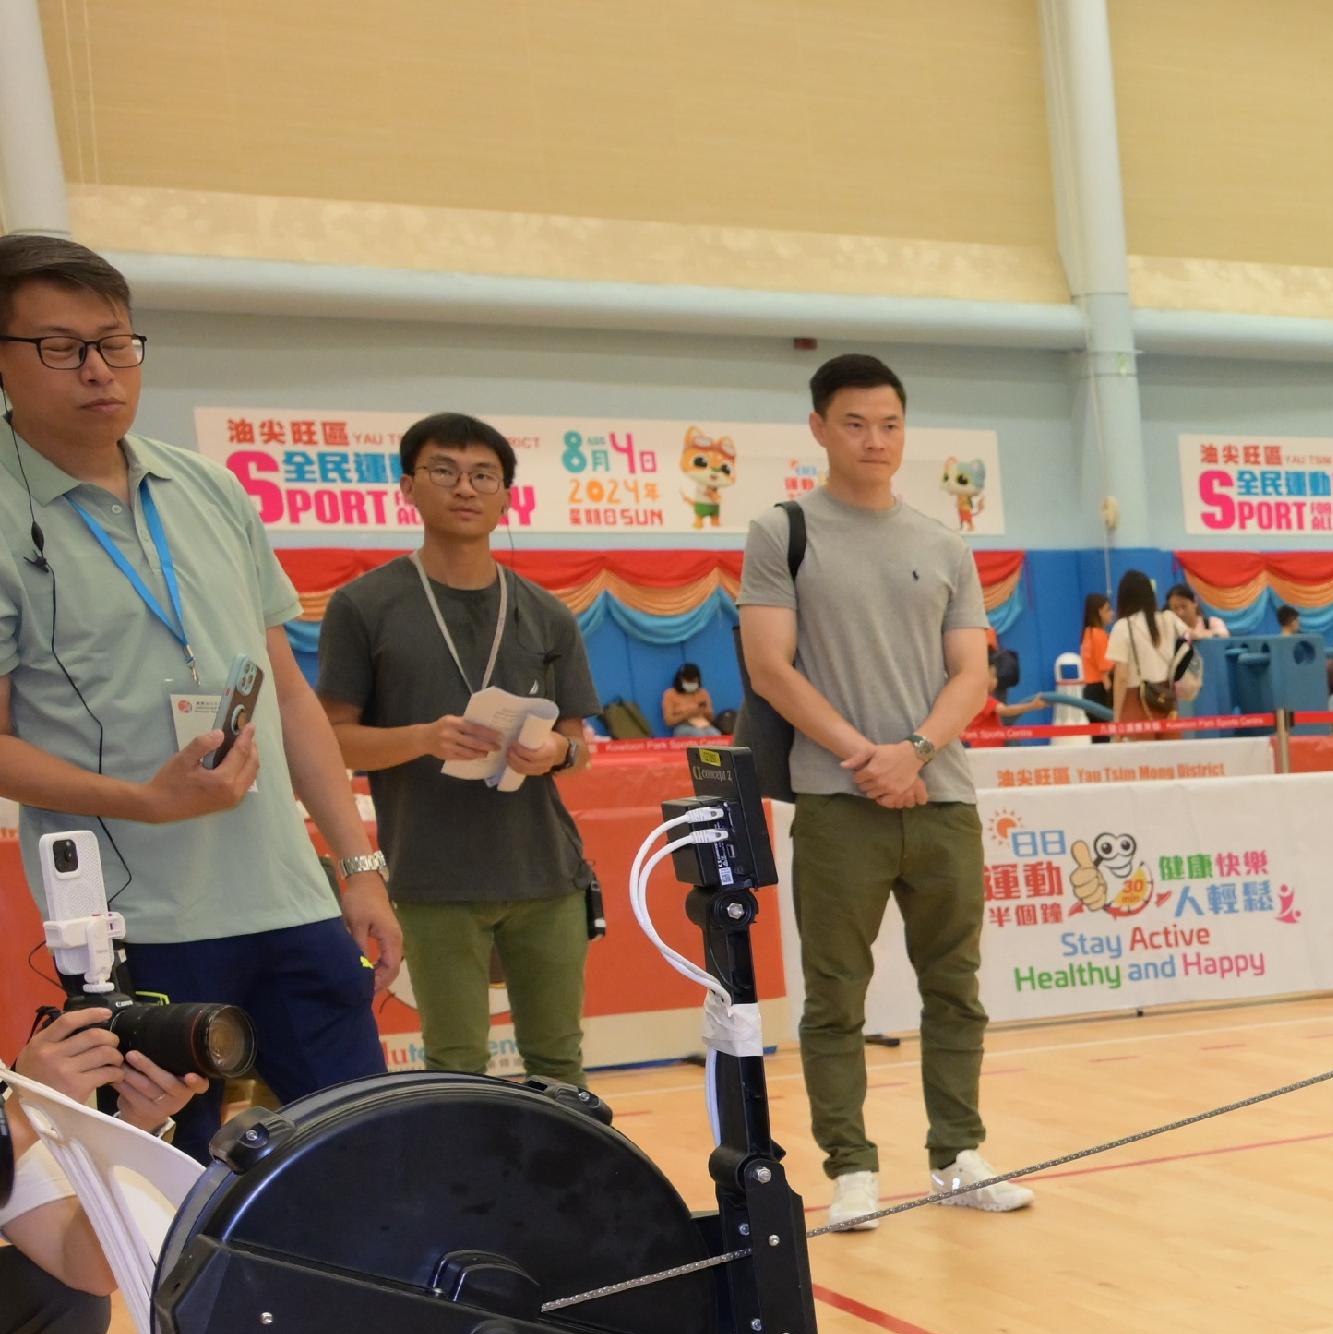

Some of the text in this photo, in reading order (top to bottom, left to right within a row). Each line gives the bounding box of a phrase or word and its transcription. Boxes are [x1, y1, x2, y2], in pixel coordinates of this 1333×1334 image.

[227, 418, 350, 446] 油尖旺區
[352, 433, 383, 445] YAU
[1200, 444, 1282, 466] 油尖旺區
[568, 479, 660, 504] 2024年
[1236, 470, 1332, 496] 全民運動
[620, 508, 664, 527] SUN
[647, 741, 667, 750] Park
[980, 729, 1004, 739] Sports
[1007, 728, 1033, 738] Centre
[1104, 767, 1136, 781] Tsim
[1139, 765, 1175, 779] Mong
[1177, 762, 1225, 777] District
[1011, 830, 1066, 858] 日日
[1159, 850, 1269, 882] 健康快樂
[984, 861, 1064, 901] 運動
[1123, 879, 1144, 893] 30
[1175, 879, 1273, 917] 人輕鬆
[988, 902, 1063, 927] 半個鐘
[1061, 925, 1210, 958] Stay Active
[1014, 952, 1265, 991] Healthy and Happy
